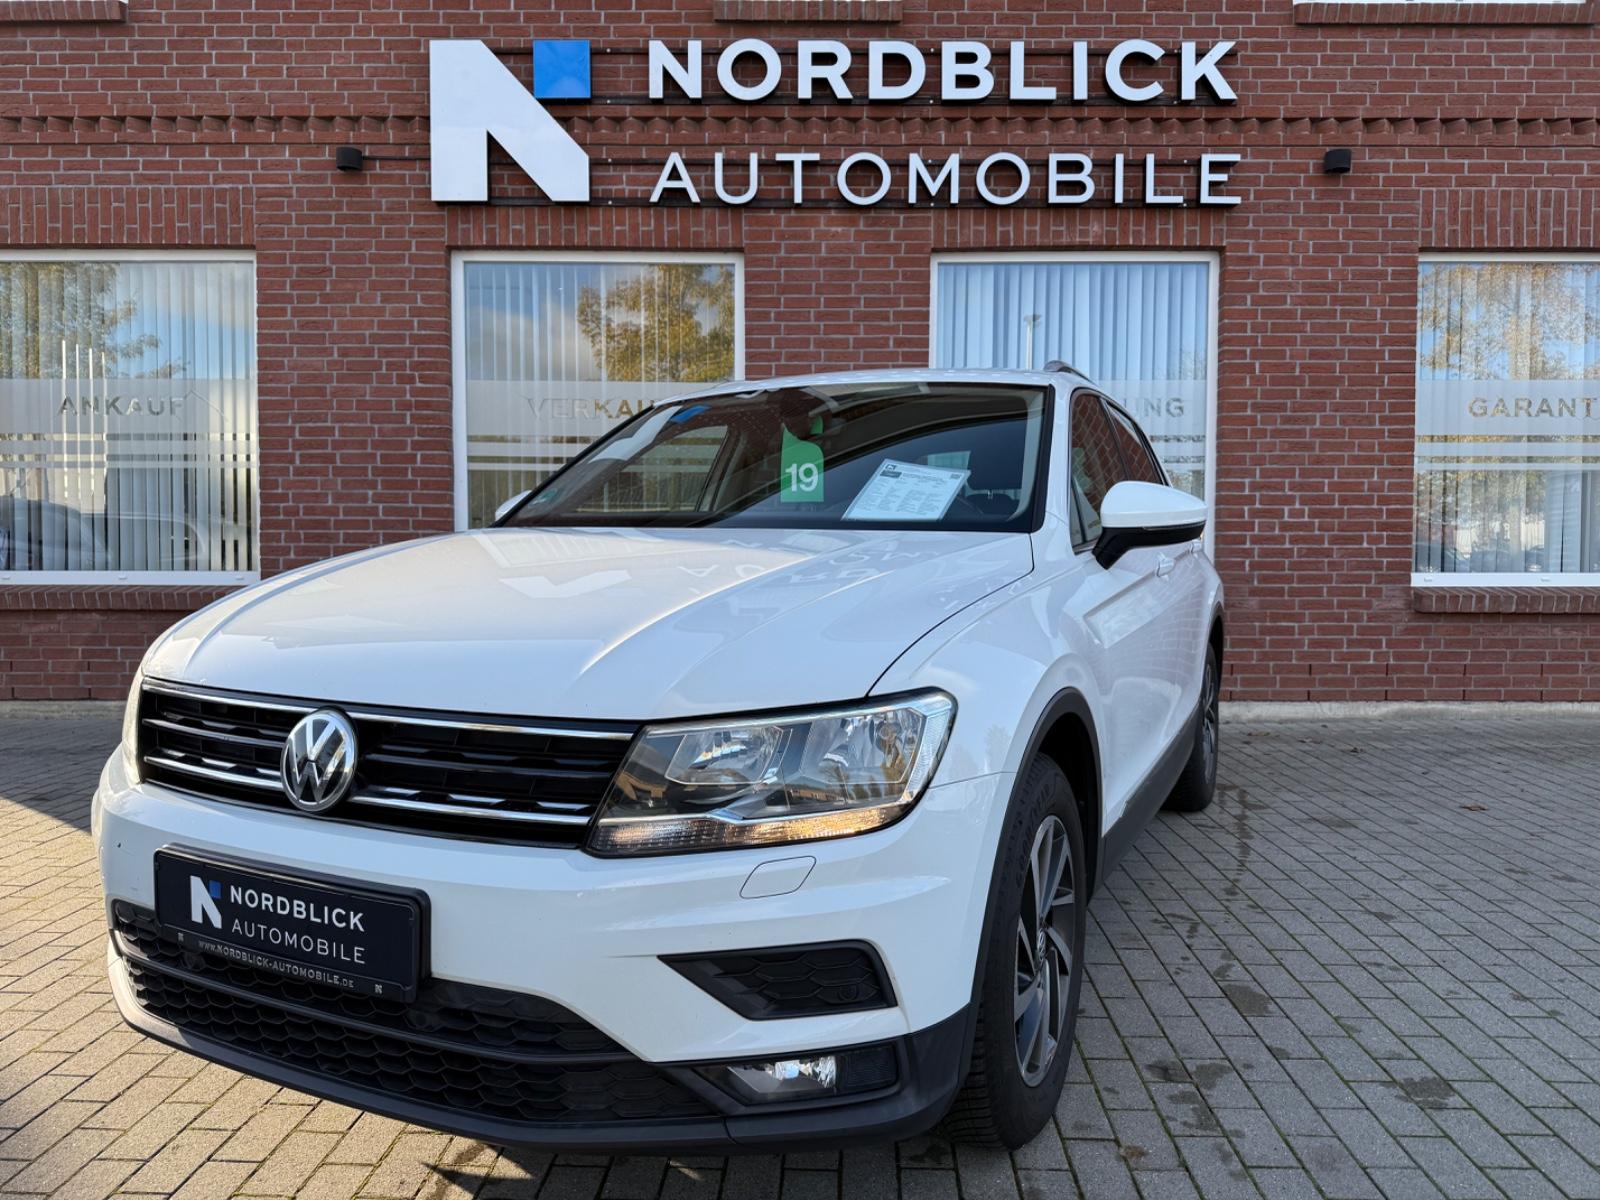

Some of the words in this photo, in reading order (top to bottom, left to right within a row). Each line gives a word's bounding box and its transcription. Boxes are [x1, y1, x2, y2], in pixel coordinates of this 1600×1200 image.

[648, 39, 1237, 102] NORDBLICK
[650, 151, 1243, 206] AUTOMOBILE
[58, 395, 184, 416] ANKAUF
[527, 398, 656, 419] VERKA
[785, 463, 819, 492] 19
[230, 885, 365, 932] NORDBLICK
[231, 918, 366, 965] AUTOMOBILE
